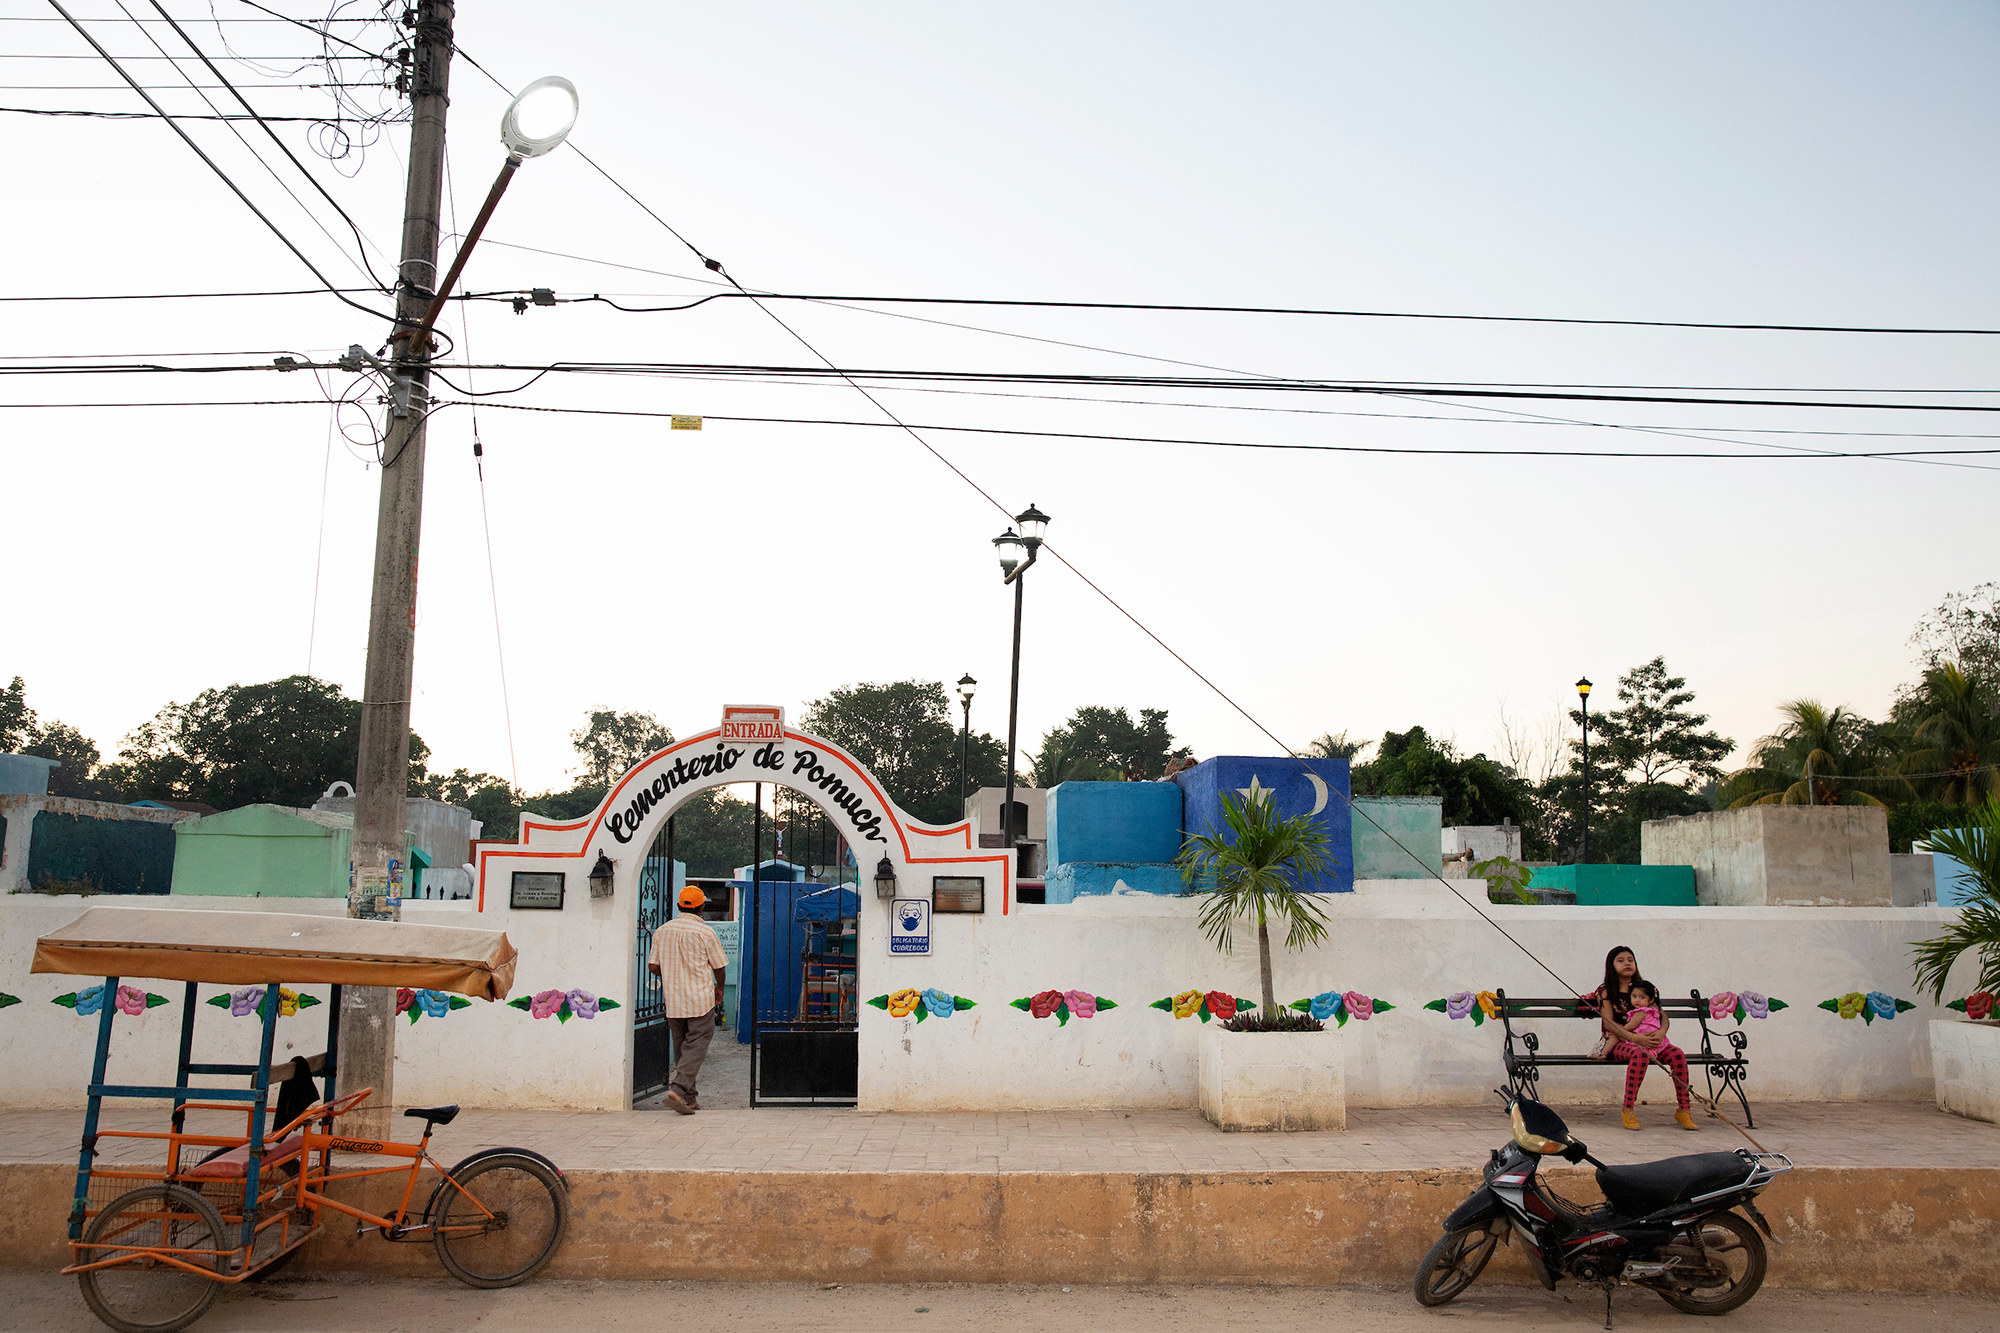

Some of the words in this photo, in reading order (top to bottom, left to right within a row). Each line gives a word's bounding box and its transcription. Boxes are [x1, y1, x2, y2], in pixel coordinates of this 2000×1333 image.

[723, 722, 782, 739] ENTRADA
[605, 743, 745, 844] Cementerio
[753, 742, 784, 770] de
[793, 750, 887, 843] Pomuch
